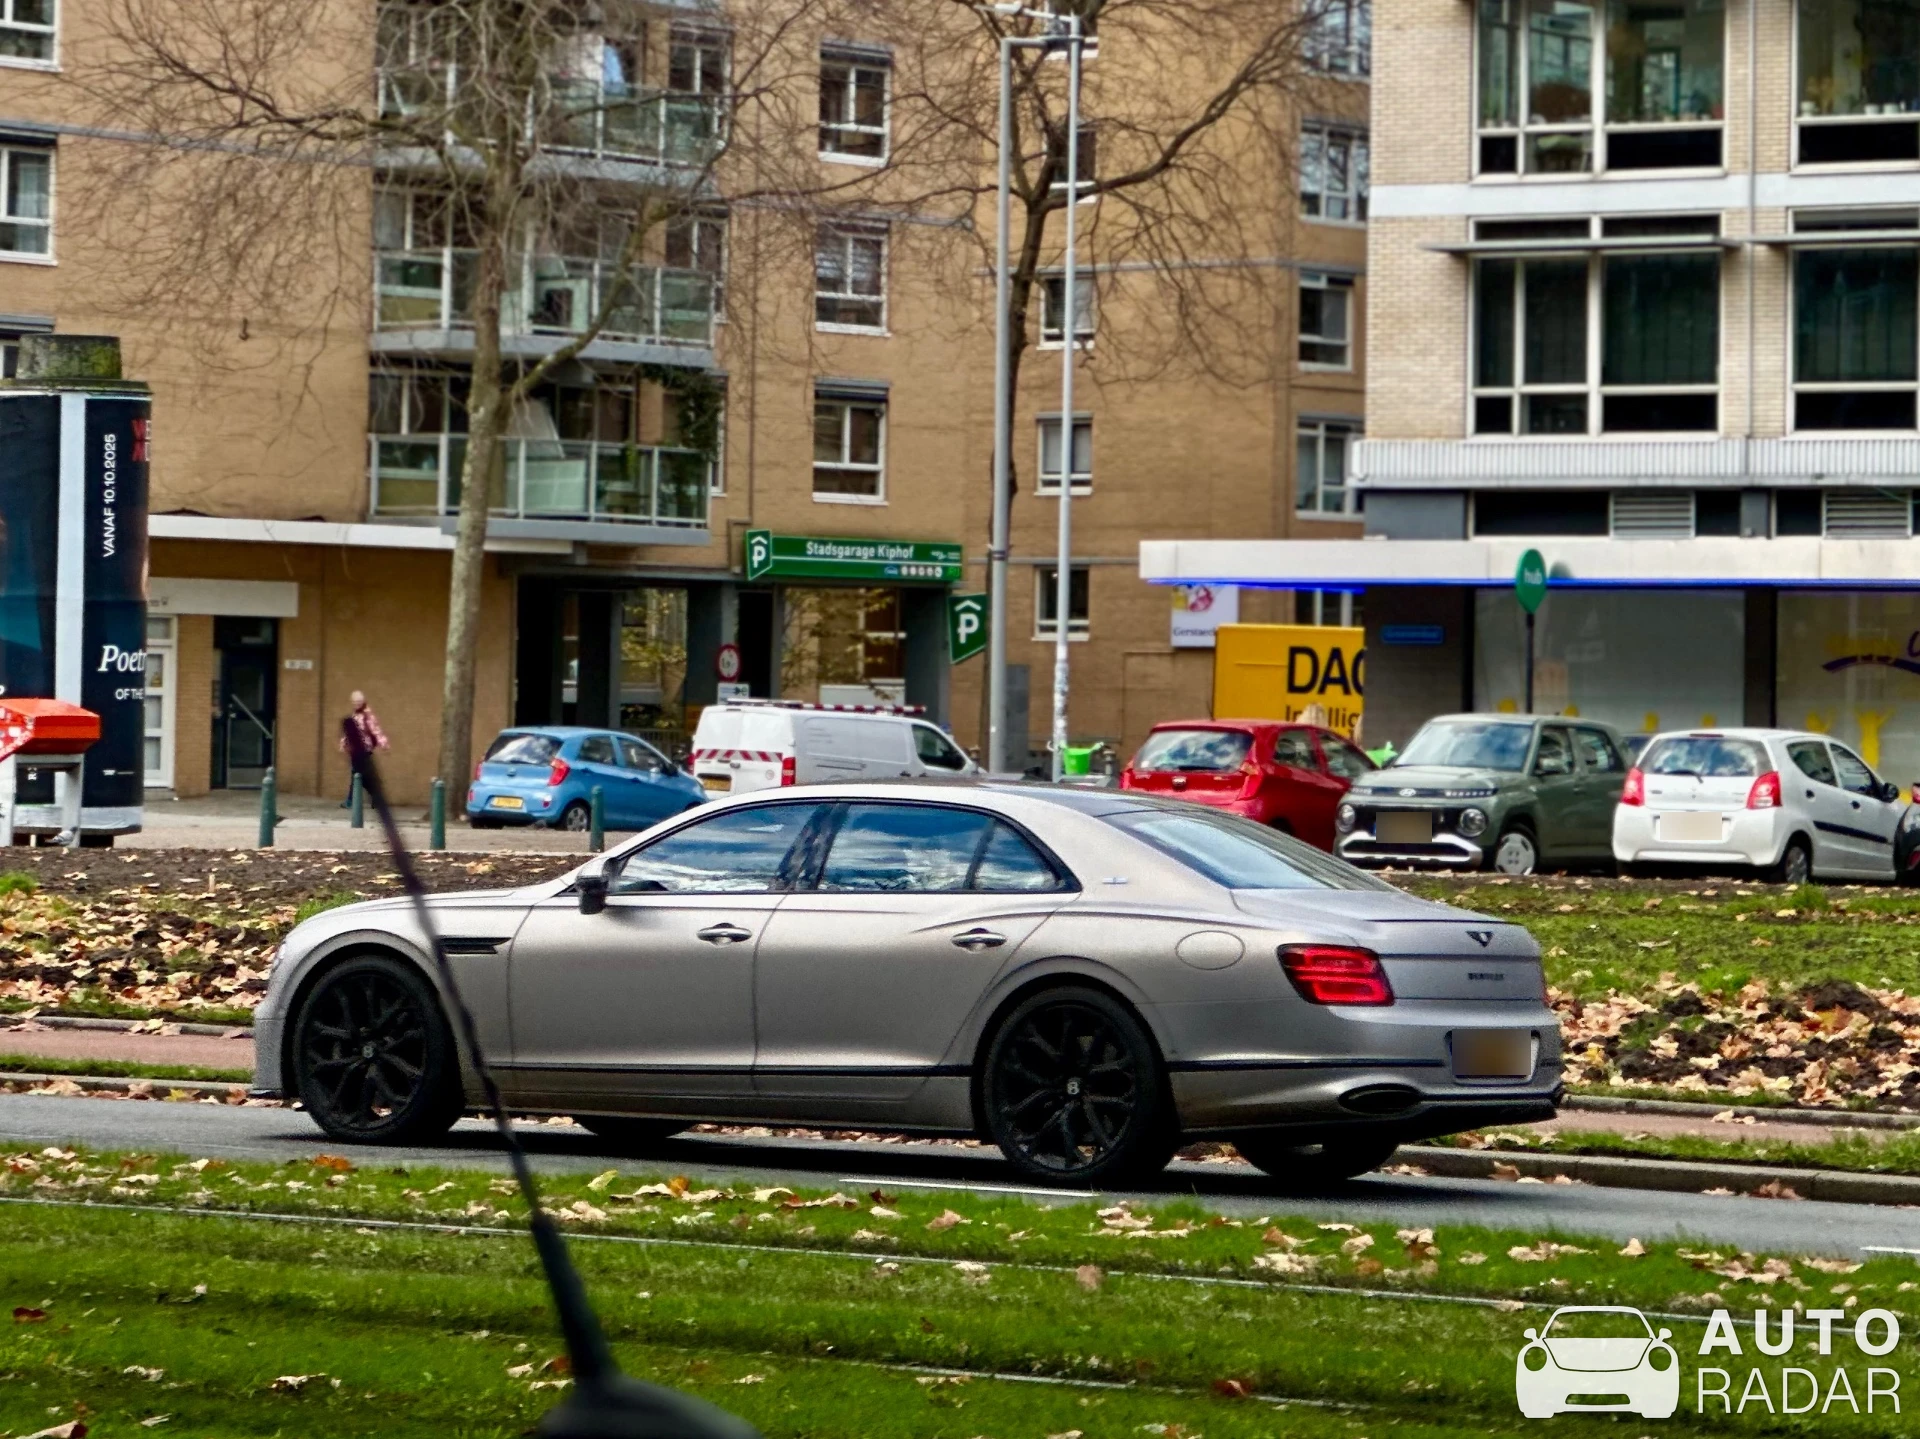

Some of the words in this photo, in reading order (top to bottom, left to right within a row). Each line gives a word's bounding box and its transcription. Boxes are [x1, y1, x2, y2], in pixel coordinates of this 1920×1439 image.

[104, 433, 116, 504] 10.10.2025
[103, 508, 116, 557] VANAF
[806, 541, 875, 559] Stadsgarage
[877, 545, 915, 559] Kiphof
[1524, 568, 1542, 584] hub
[957, 613, 979, 643] P
[115, 688, 130, 700] OF
